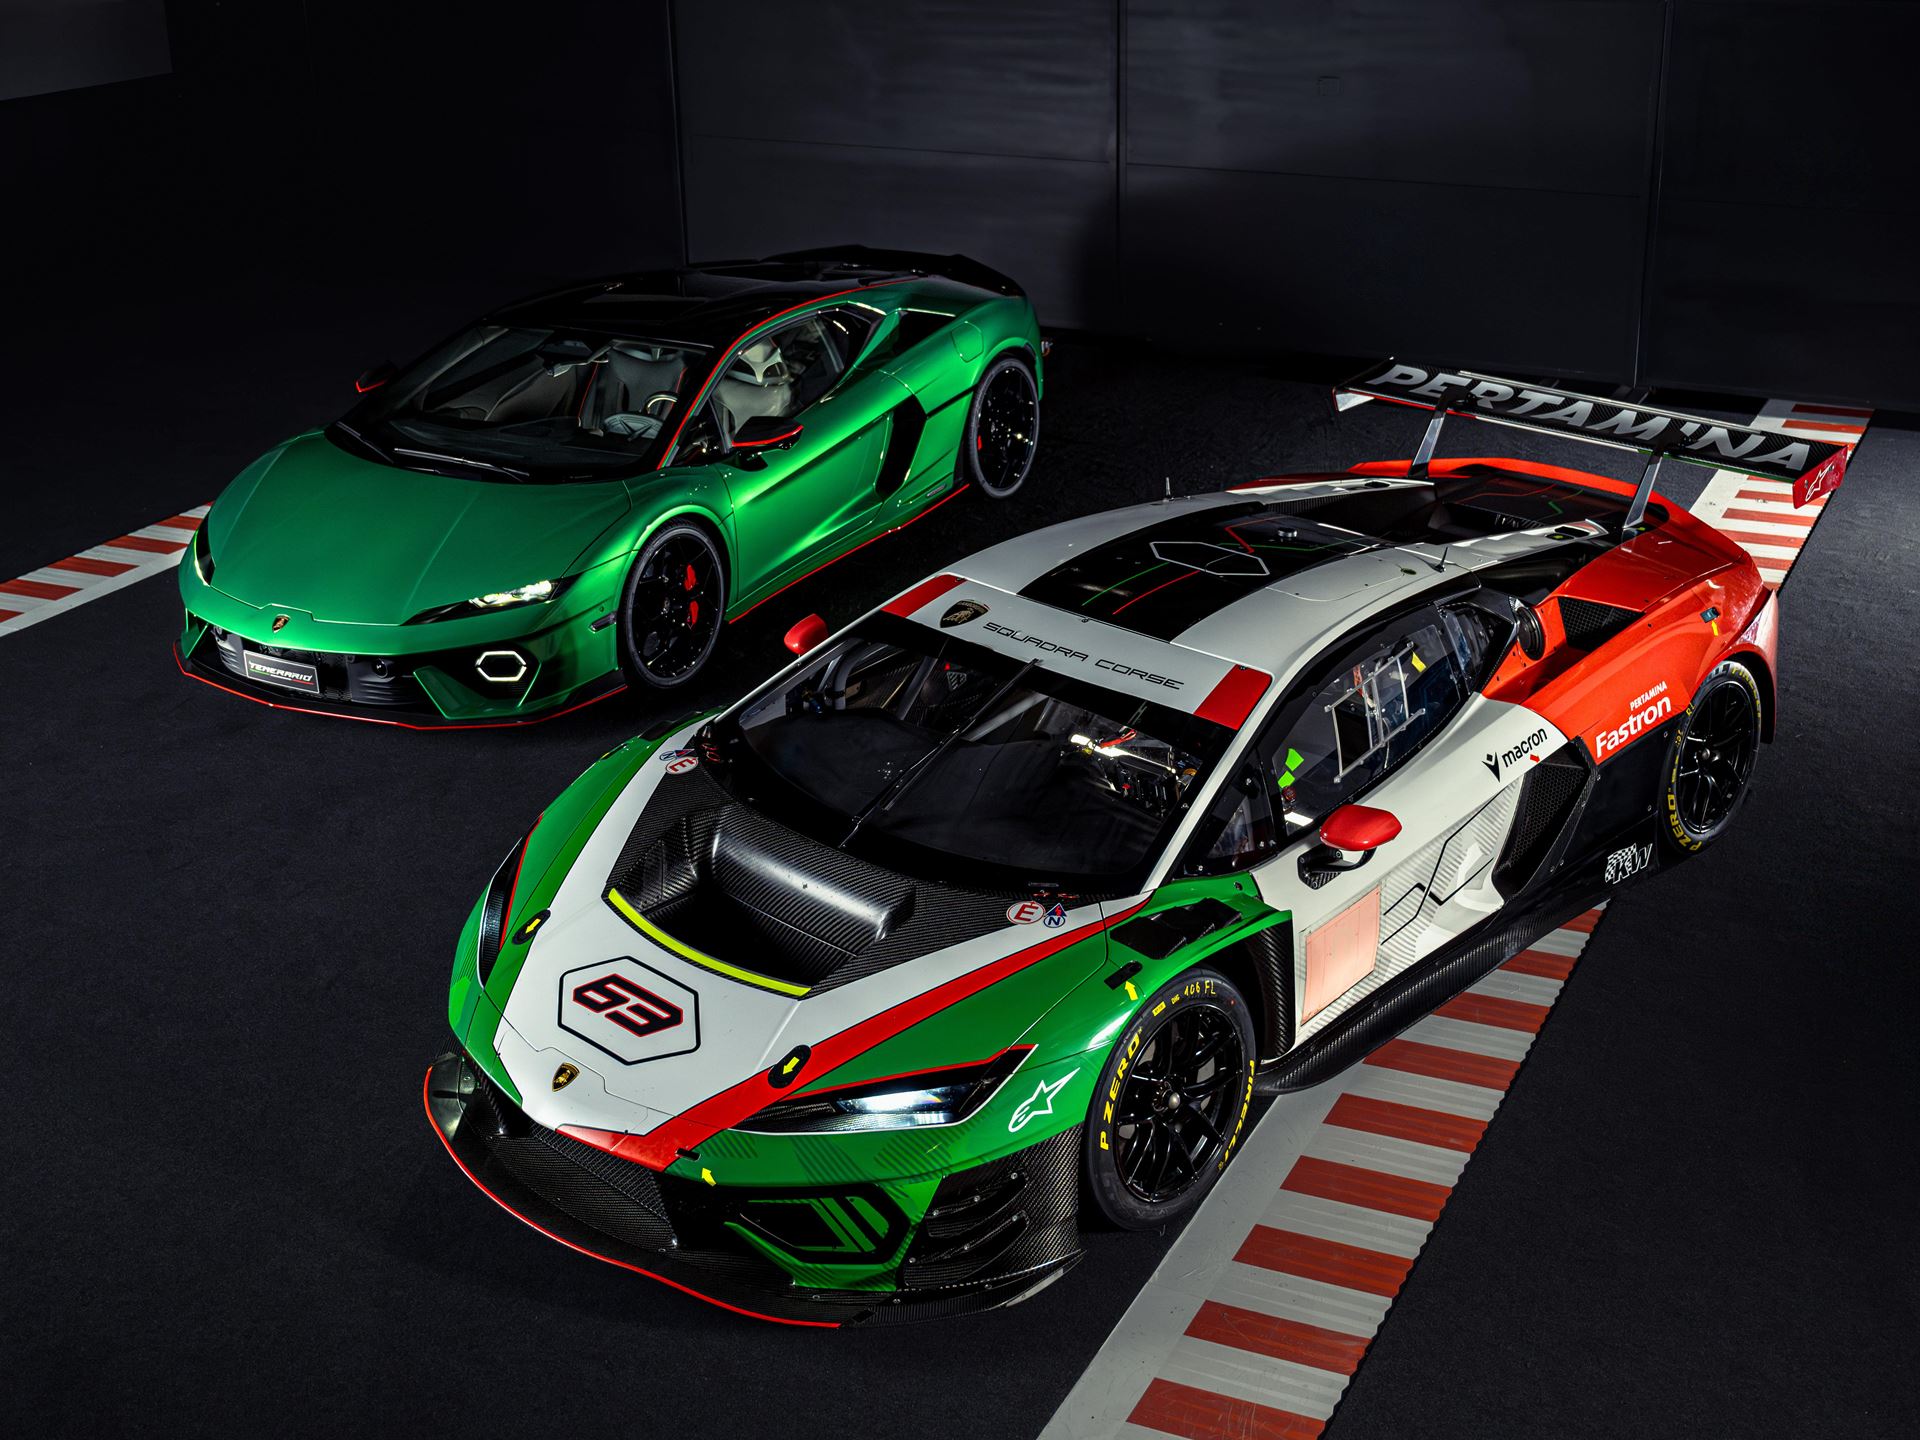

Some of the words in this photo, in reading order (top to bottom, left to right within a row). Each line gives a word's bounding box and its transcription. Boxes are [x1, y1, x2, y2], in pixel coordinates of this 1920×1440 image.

[982, 621, 1089, 662] SQUADRA
[1095, 659, 1185, 691] CORSE
[1629, 680, 1668, 711] PERTAMINA
[1501, 728, 1547, 768] macron
[1596, 696, 1672, 758] Fastron
[1013, 903, 1039, 922] E
[572, 973, 684, 1037] 63
[1103, 1034, 1141, 1125] ZERO
[1100, 1131, 1110, 1150] P
